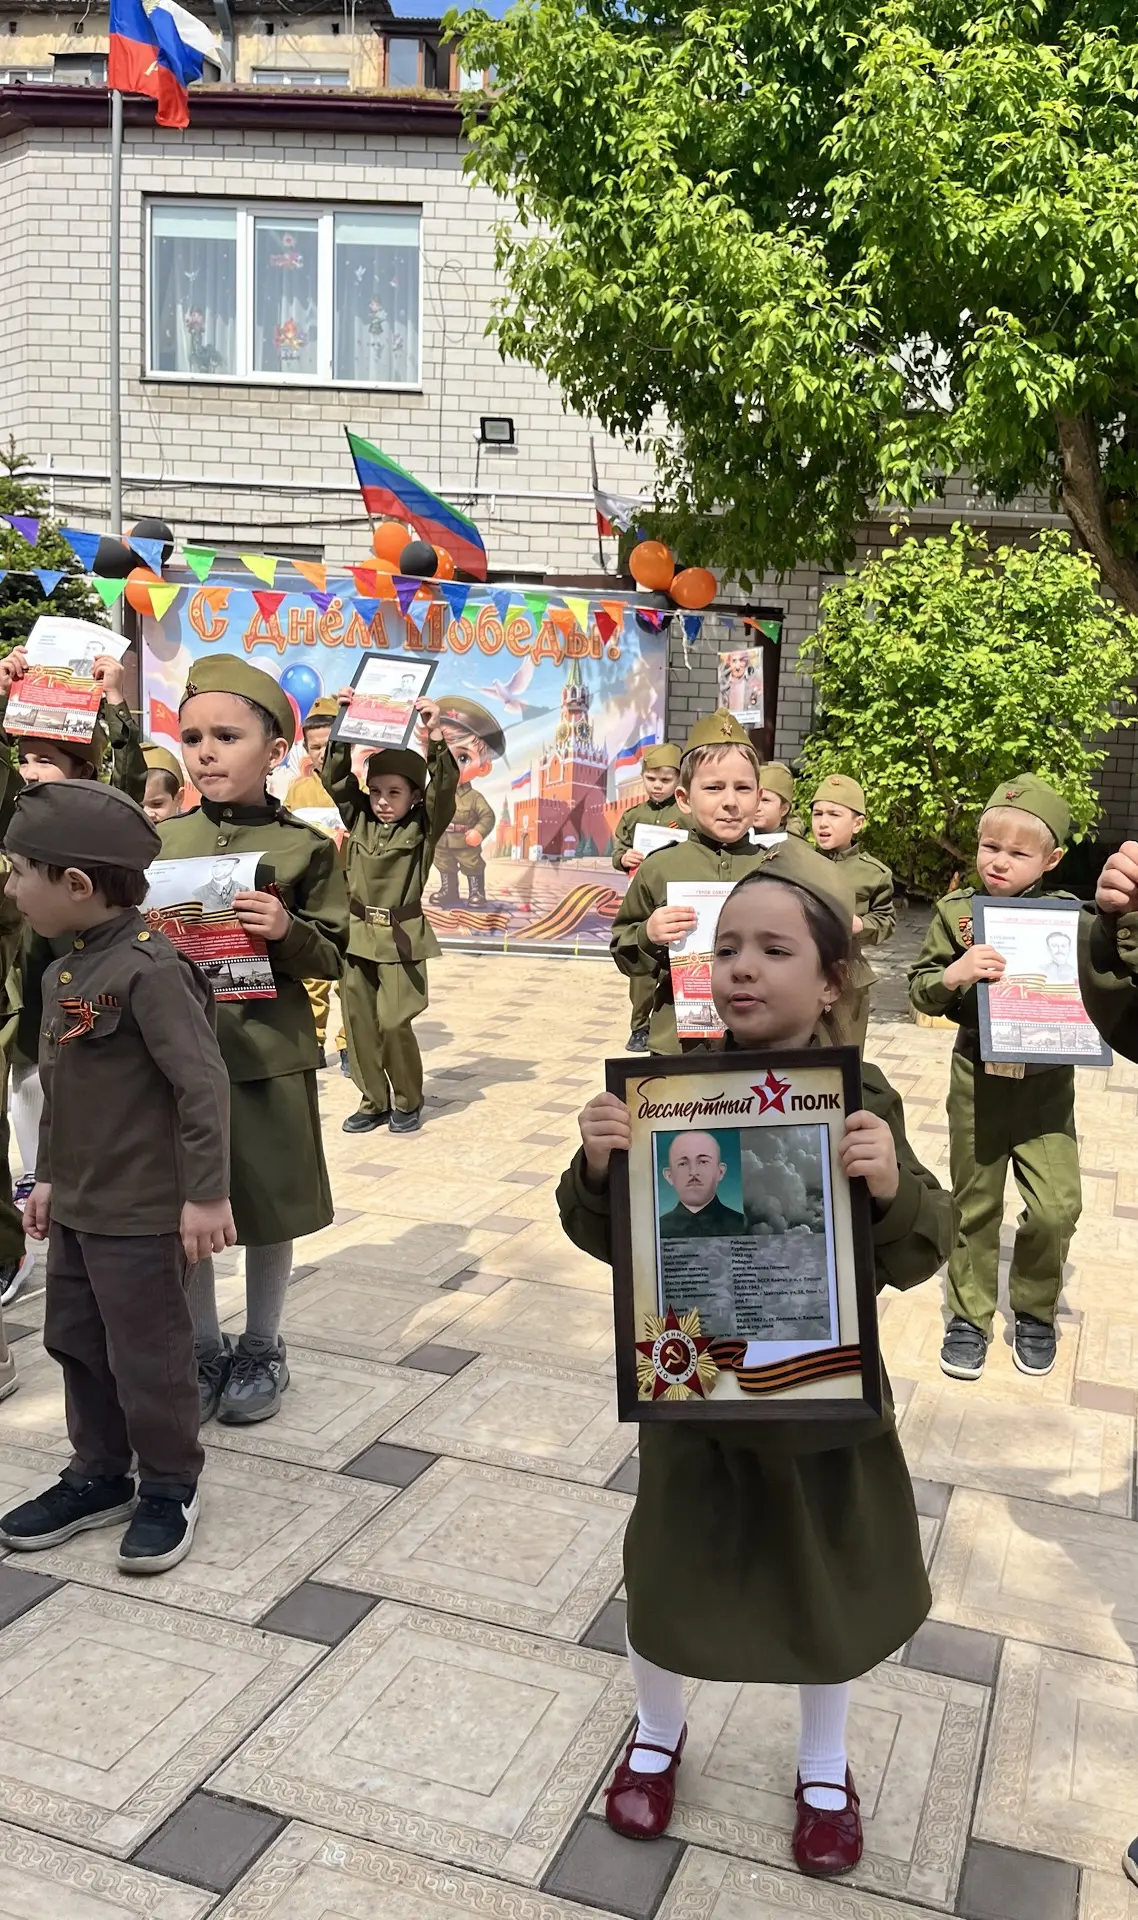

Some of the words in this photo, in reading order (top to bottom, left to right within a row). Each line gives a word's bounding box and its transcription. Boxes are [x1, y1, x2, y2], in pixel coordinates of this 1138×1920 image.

[187, 590, 229, 643] С
[242, 596, 390, 655] Днём
[636, 1075, 755, 1123] бессмертный
[653, 1331, 692, 1380] ОТЕЧЕСТВЕННАЯ
